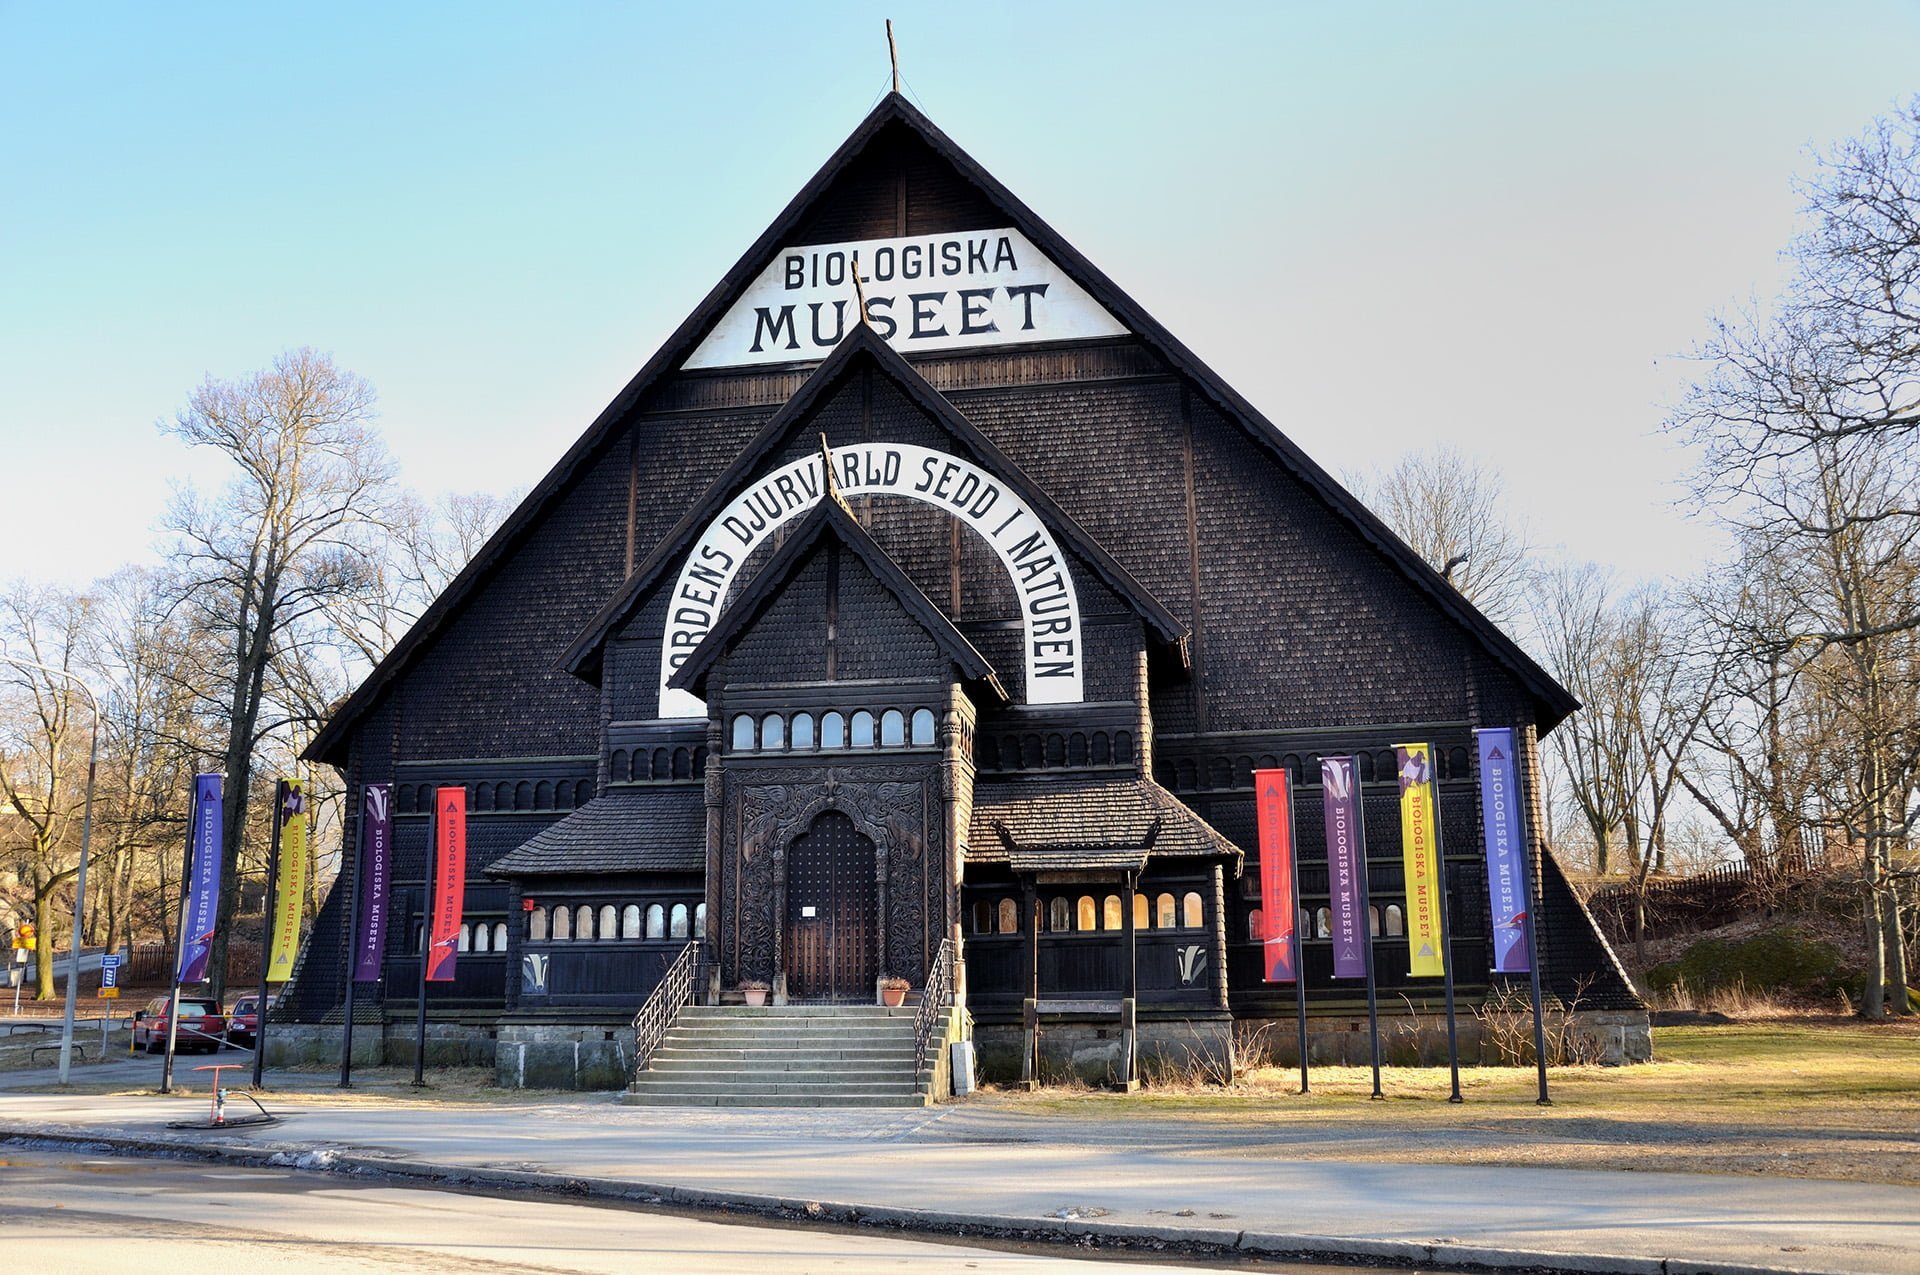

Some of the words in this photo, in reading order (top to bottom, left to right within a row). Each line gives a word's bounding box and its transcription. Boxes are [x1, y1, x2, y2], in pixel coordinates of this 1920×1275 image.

[784, 237, 1018, 290] BIOLOGISKA
[749, 283, 1050, 352] MUSEET
[915, 457, 1000, 519] SEDD
[991, 507, 1023, 538] I
[668, 544, 733, 680] RDENS
[1006, 530, 1075, 679] NATUREN
[202, 808, 213, 885] BIOLOGISKA
[1336, 807, 1349, 886] BIOLOGISKA
[1412, 797, 1425, 879] BIOLOGISKA
[1492, 768, 1508, 857] BIOLOGISKA
[287, 825, 299, 898] BIOLOGISKA
[372, 830, 383, 900] BIOLOGISKA
[447, 820, 456, 890] BIOLOGISKA
[283, 903, 295, 949] MUSEET
[368, 905, 380, 951] MUSEET
[1340, 892, 1352, 943] MUSEET
[1417, 885, 1430, 938] MUSEET
